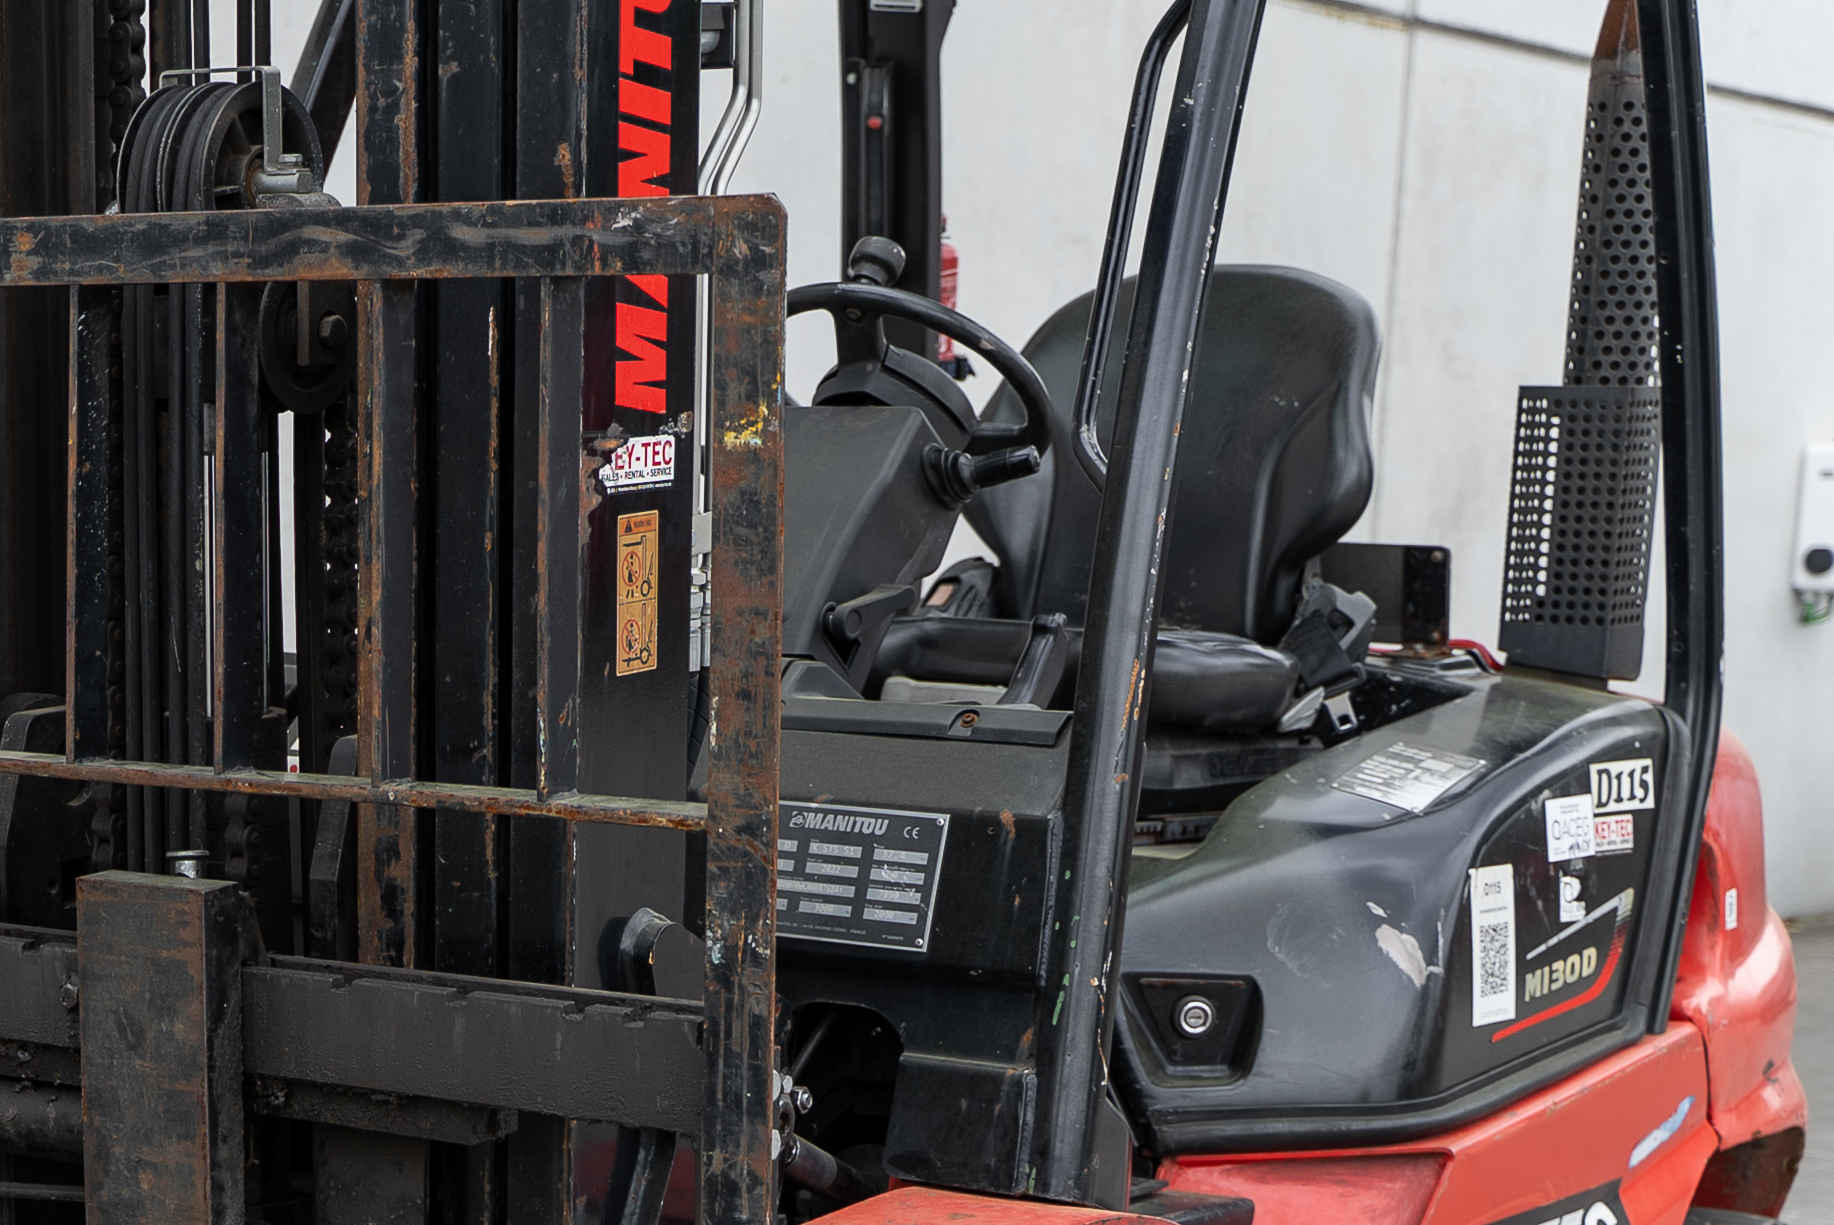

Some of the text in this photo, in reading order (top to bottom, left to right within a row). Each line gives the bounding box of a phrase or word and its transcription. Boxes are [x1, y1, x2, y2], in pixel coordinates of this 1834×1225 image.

[615, 0, 672, 413] MNIT
[612, 440, 672, 470] EY-TEC
[625, 469, 645, 479] RENTAL
[650, 466, 672, 477] SERVICE
[1596, 765, 1649, 808] D115
[804, 812, 889, 836] MANITOU
